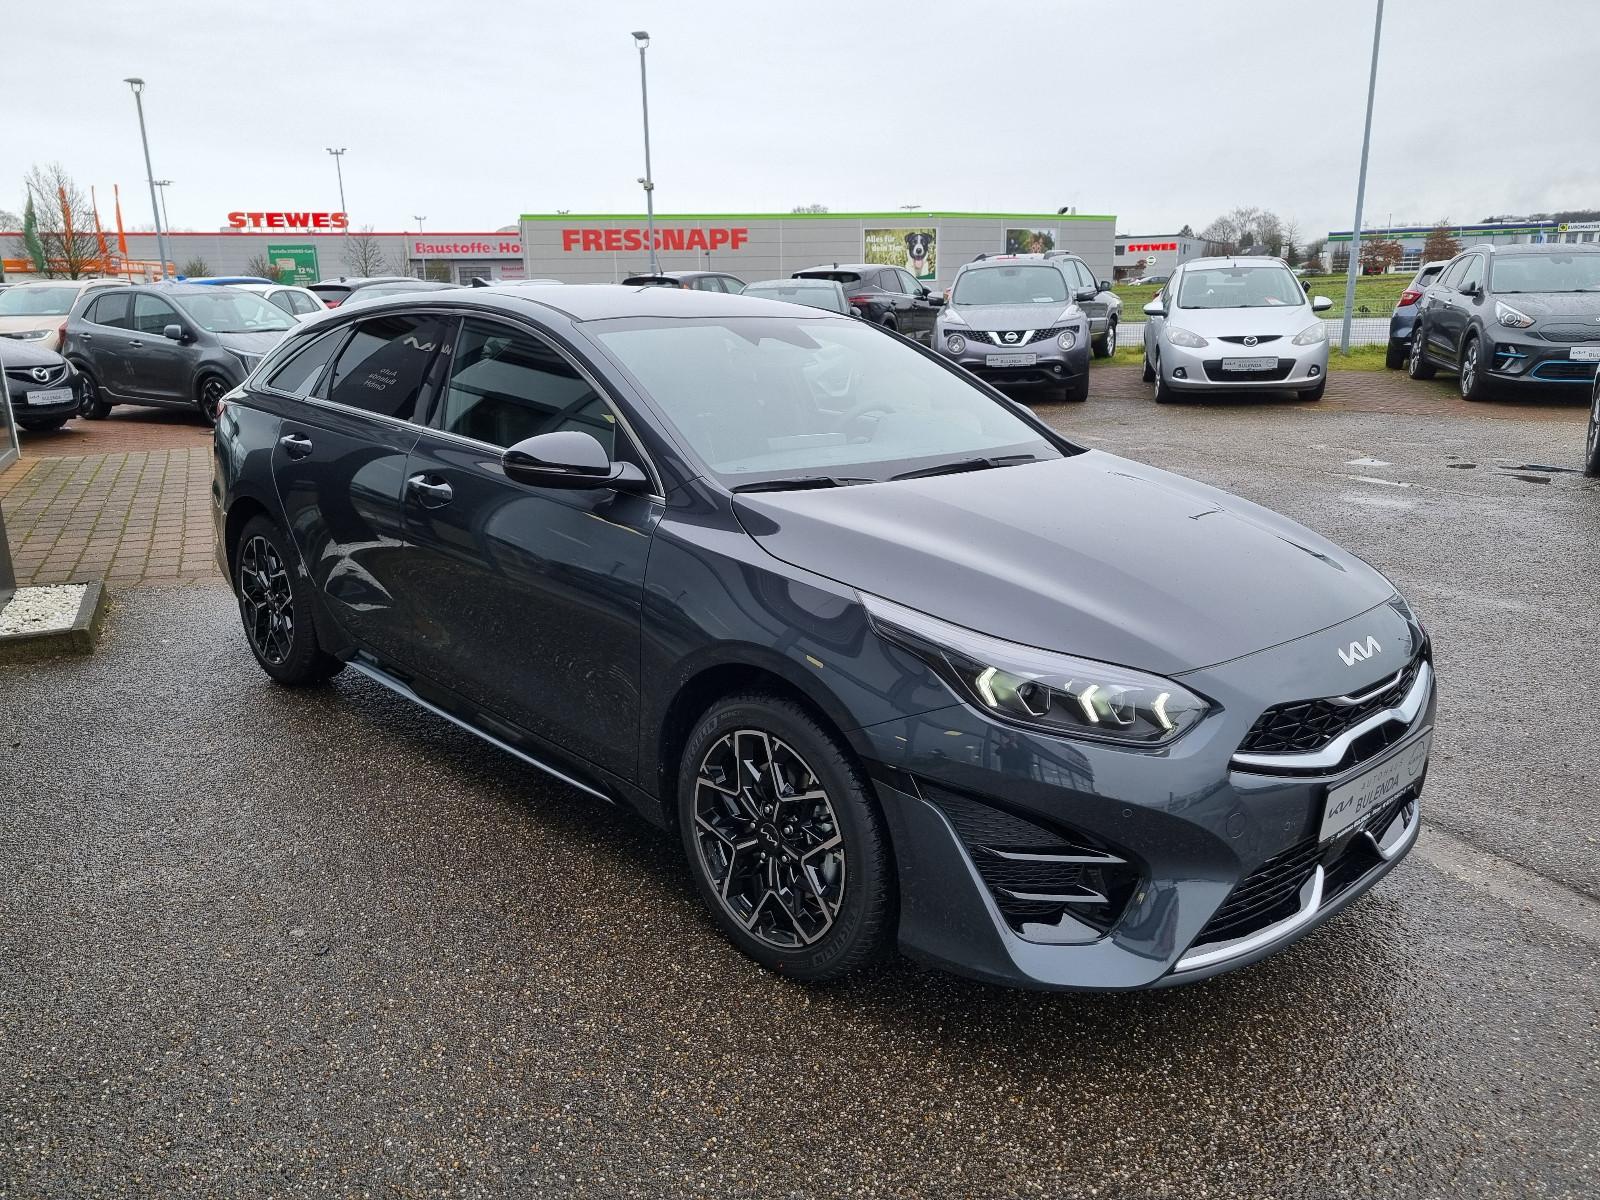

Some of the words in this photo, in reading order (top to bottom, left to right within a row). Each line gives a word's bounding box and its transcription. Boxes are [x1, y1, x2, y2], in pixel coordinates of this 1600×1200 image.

[228, 212, 349, 228] STEWES
[562, 228, 748, 251] FRESSNAPF
[866, 235, 883, 243] Alles
[884, 235, 896, 243] für
[415, 242, 491, 254] Baustoffe
[1128, 242, 1177, 252] STEWES
[1355, 773, 1400, 813] BULENDA
